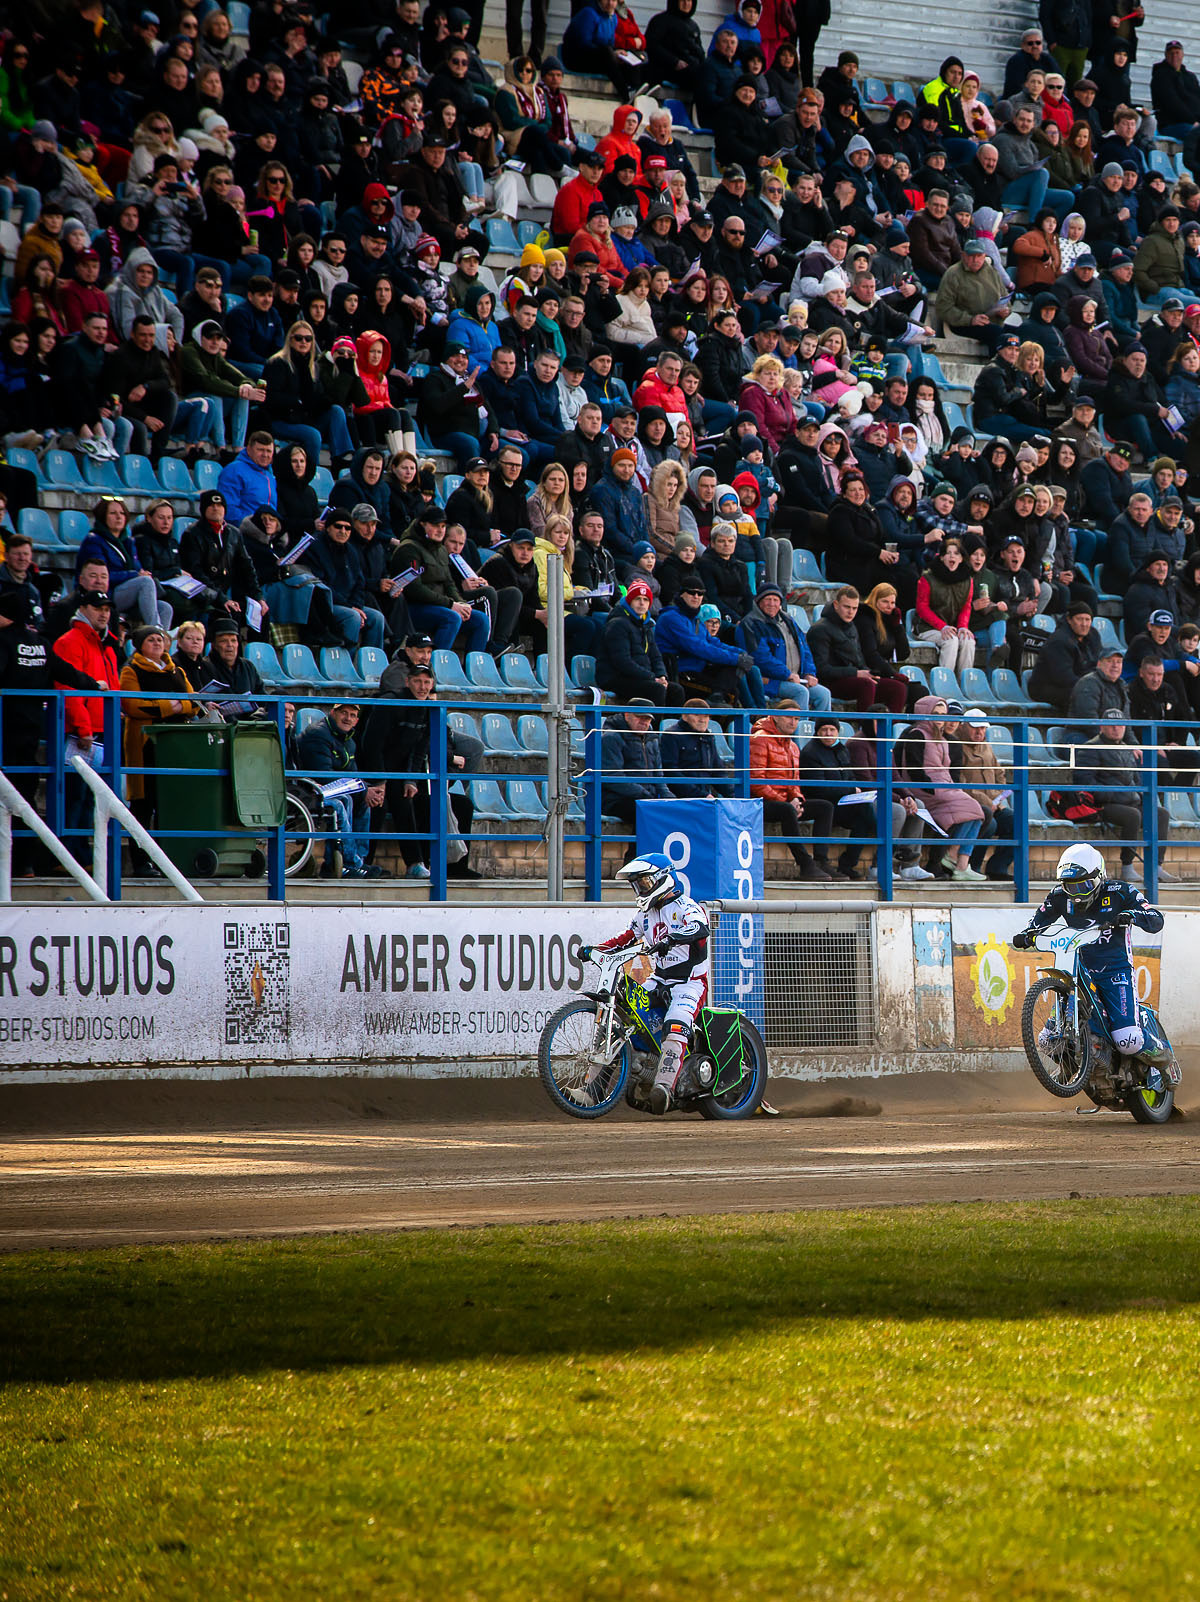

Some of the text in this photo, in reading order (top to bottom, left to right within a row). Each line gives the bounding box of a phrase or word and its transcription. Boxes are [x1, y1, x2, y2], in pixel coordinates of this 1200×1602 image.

[29, 935, 176, 996] STUDIOS
[339, 933, 584, 992] AMBER STUDIOS
[0, 1015, 156, 1042] BER-STUDIOS.COM
